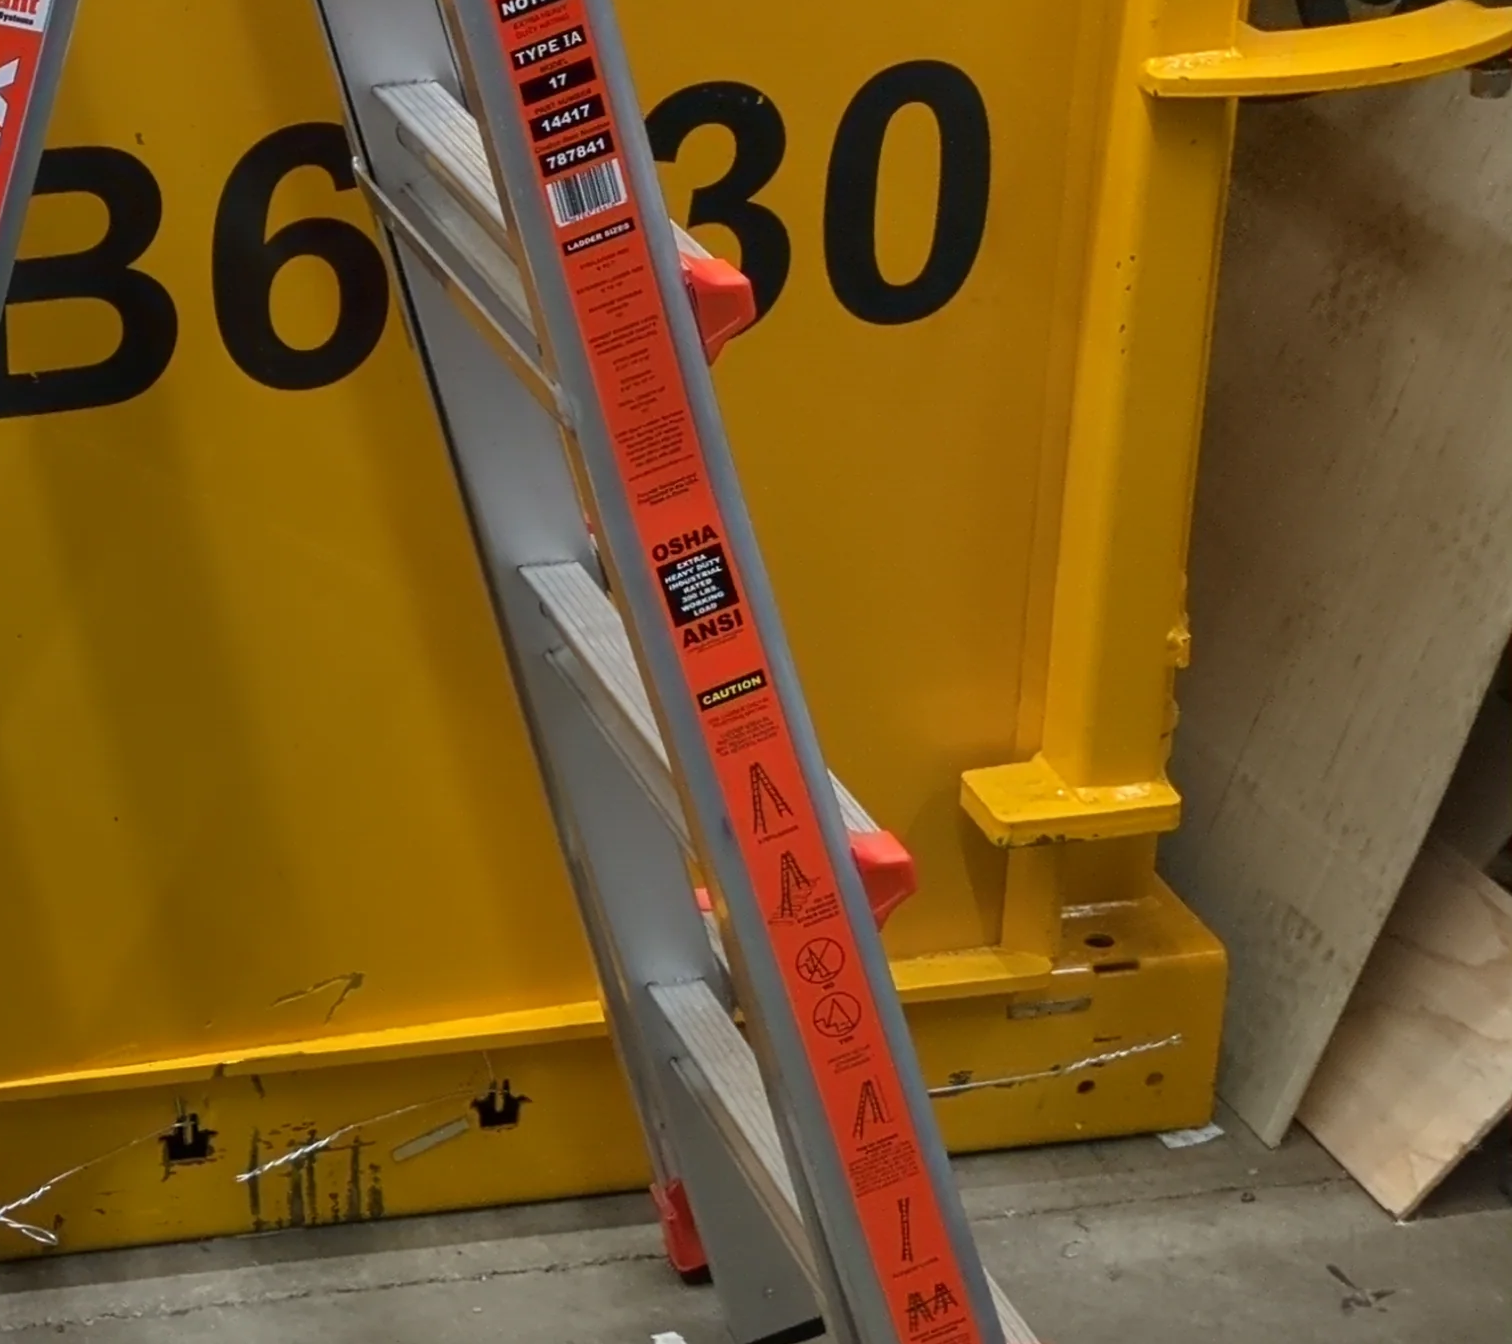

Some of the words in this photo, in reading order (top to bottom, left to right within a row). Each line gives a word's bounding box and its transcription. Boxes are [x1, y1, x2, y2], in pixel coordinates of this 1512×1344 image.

[514, 39, 560, 66] TYPE
[563, 30, 583, 48] IA
[548, 72, 568, 90] 17
[540, 103, 591, 133] 14417
[546, 137, 606, 171] 787841
[566, 229, 603, 252] LADDER
[603, 221, 631, 238] SIZES
[652, 524, 718, 562] OSHA
[664, 567, 694, 584] HEAVY
[695, 557, 722, 572] DUTY
[676, 553, 707, 570] EXTRA
[668, 565, 723, 591] INDUSTRIAL
[683, 578, 713, 595] RATED
[680, 590, 725, 613] WORKING
[693, 602, 718, 617] LOAD
[683, 609, 743, 648] ANSI
[701, 675, 762, 706] CAUTION
